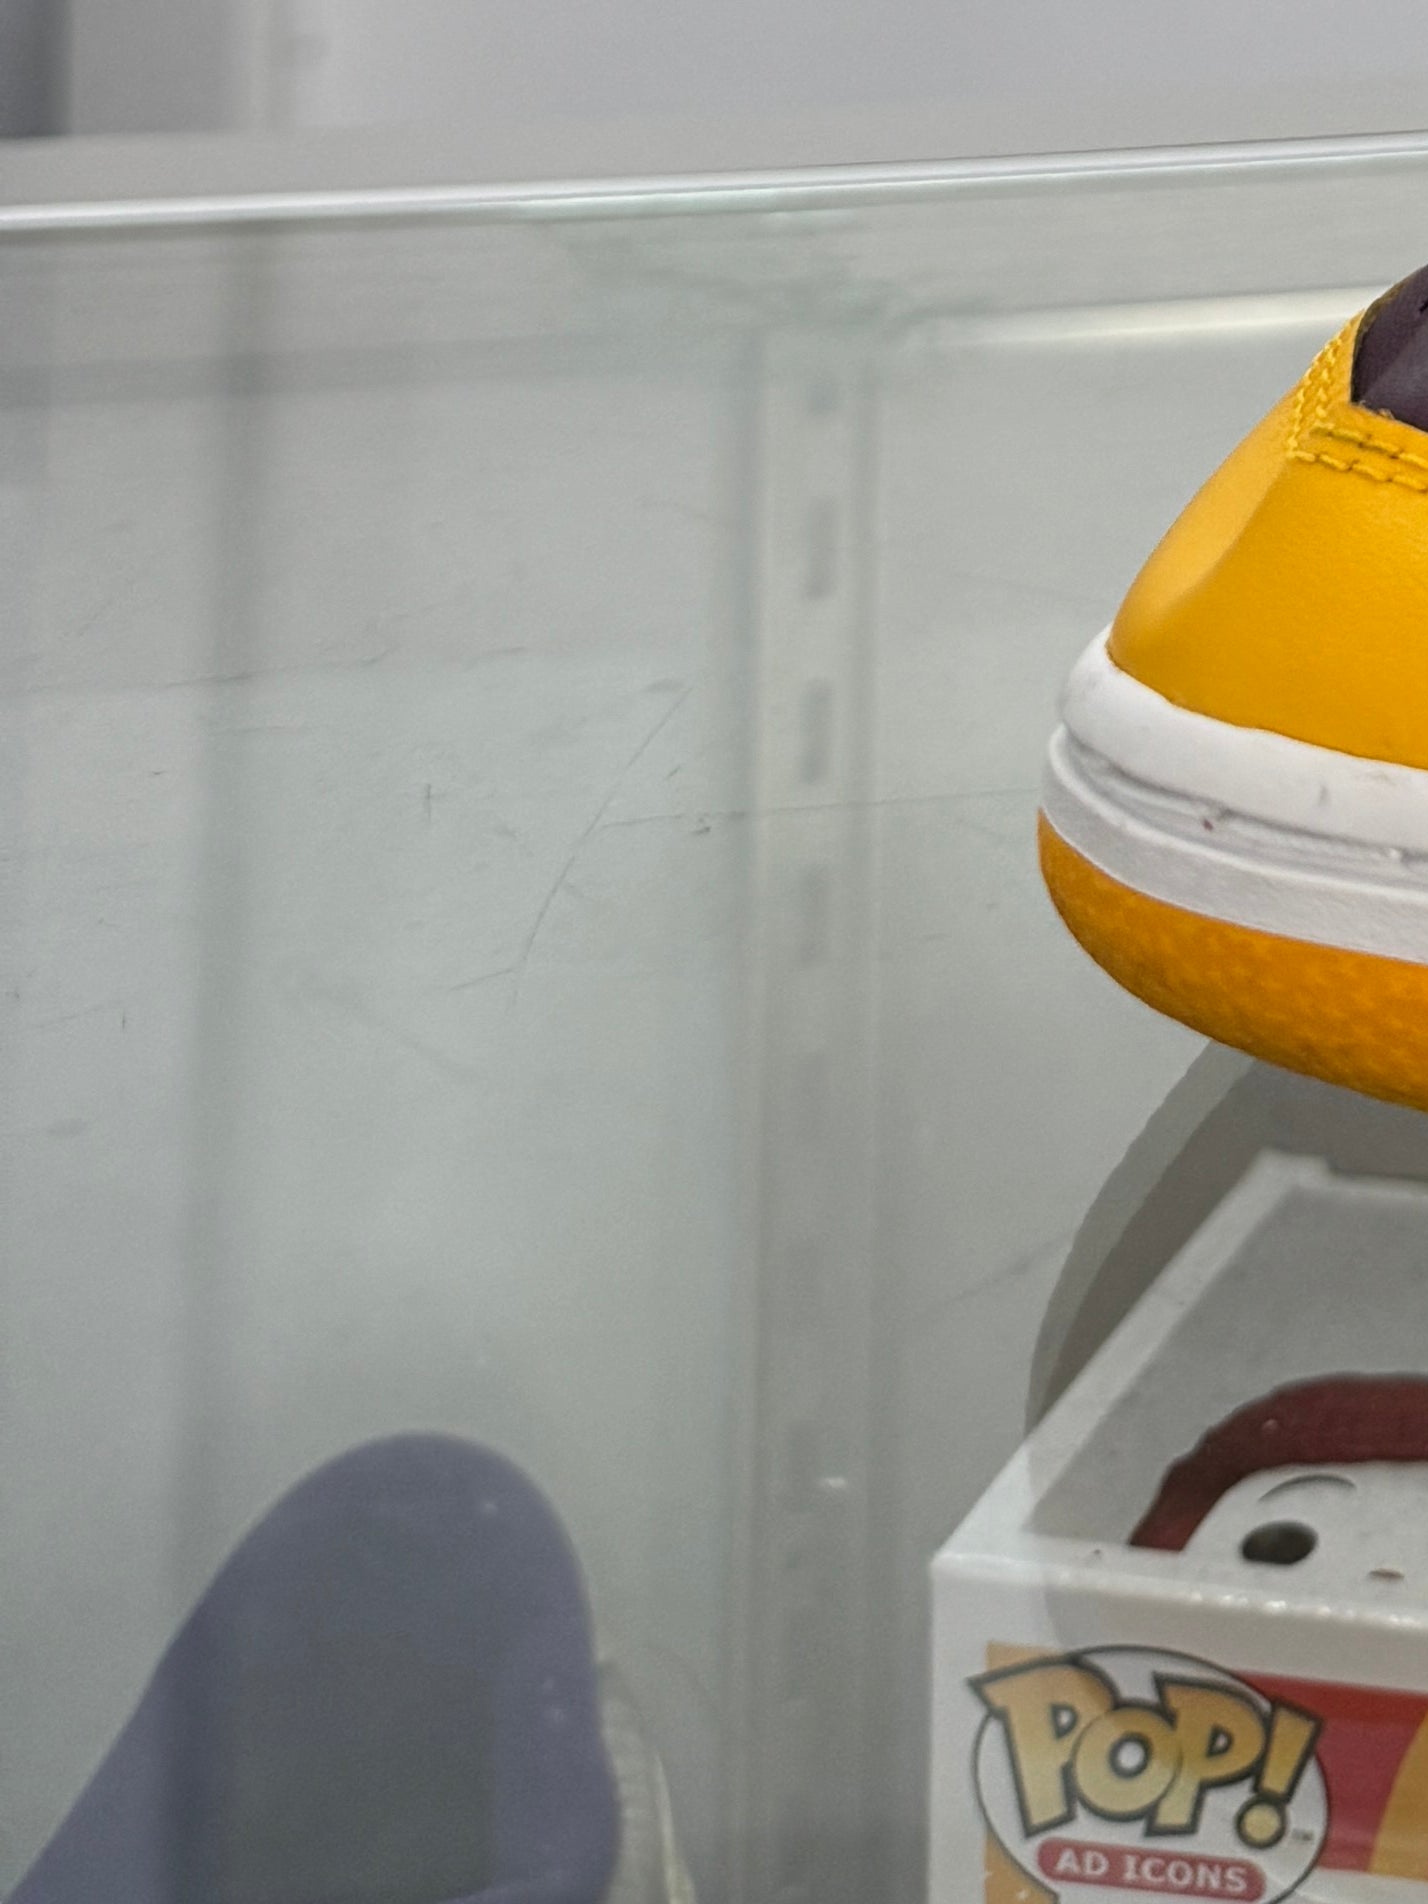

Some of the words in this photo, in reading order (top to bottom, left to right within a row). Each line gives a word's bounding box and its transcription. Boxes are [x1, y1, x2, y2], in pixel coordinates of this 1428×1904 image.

[966, 1655, 1323, 1850] POP!
[1055, 1848, 1109, 1879] AD
[1121, 1855, 1249, 1893] ICONS
